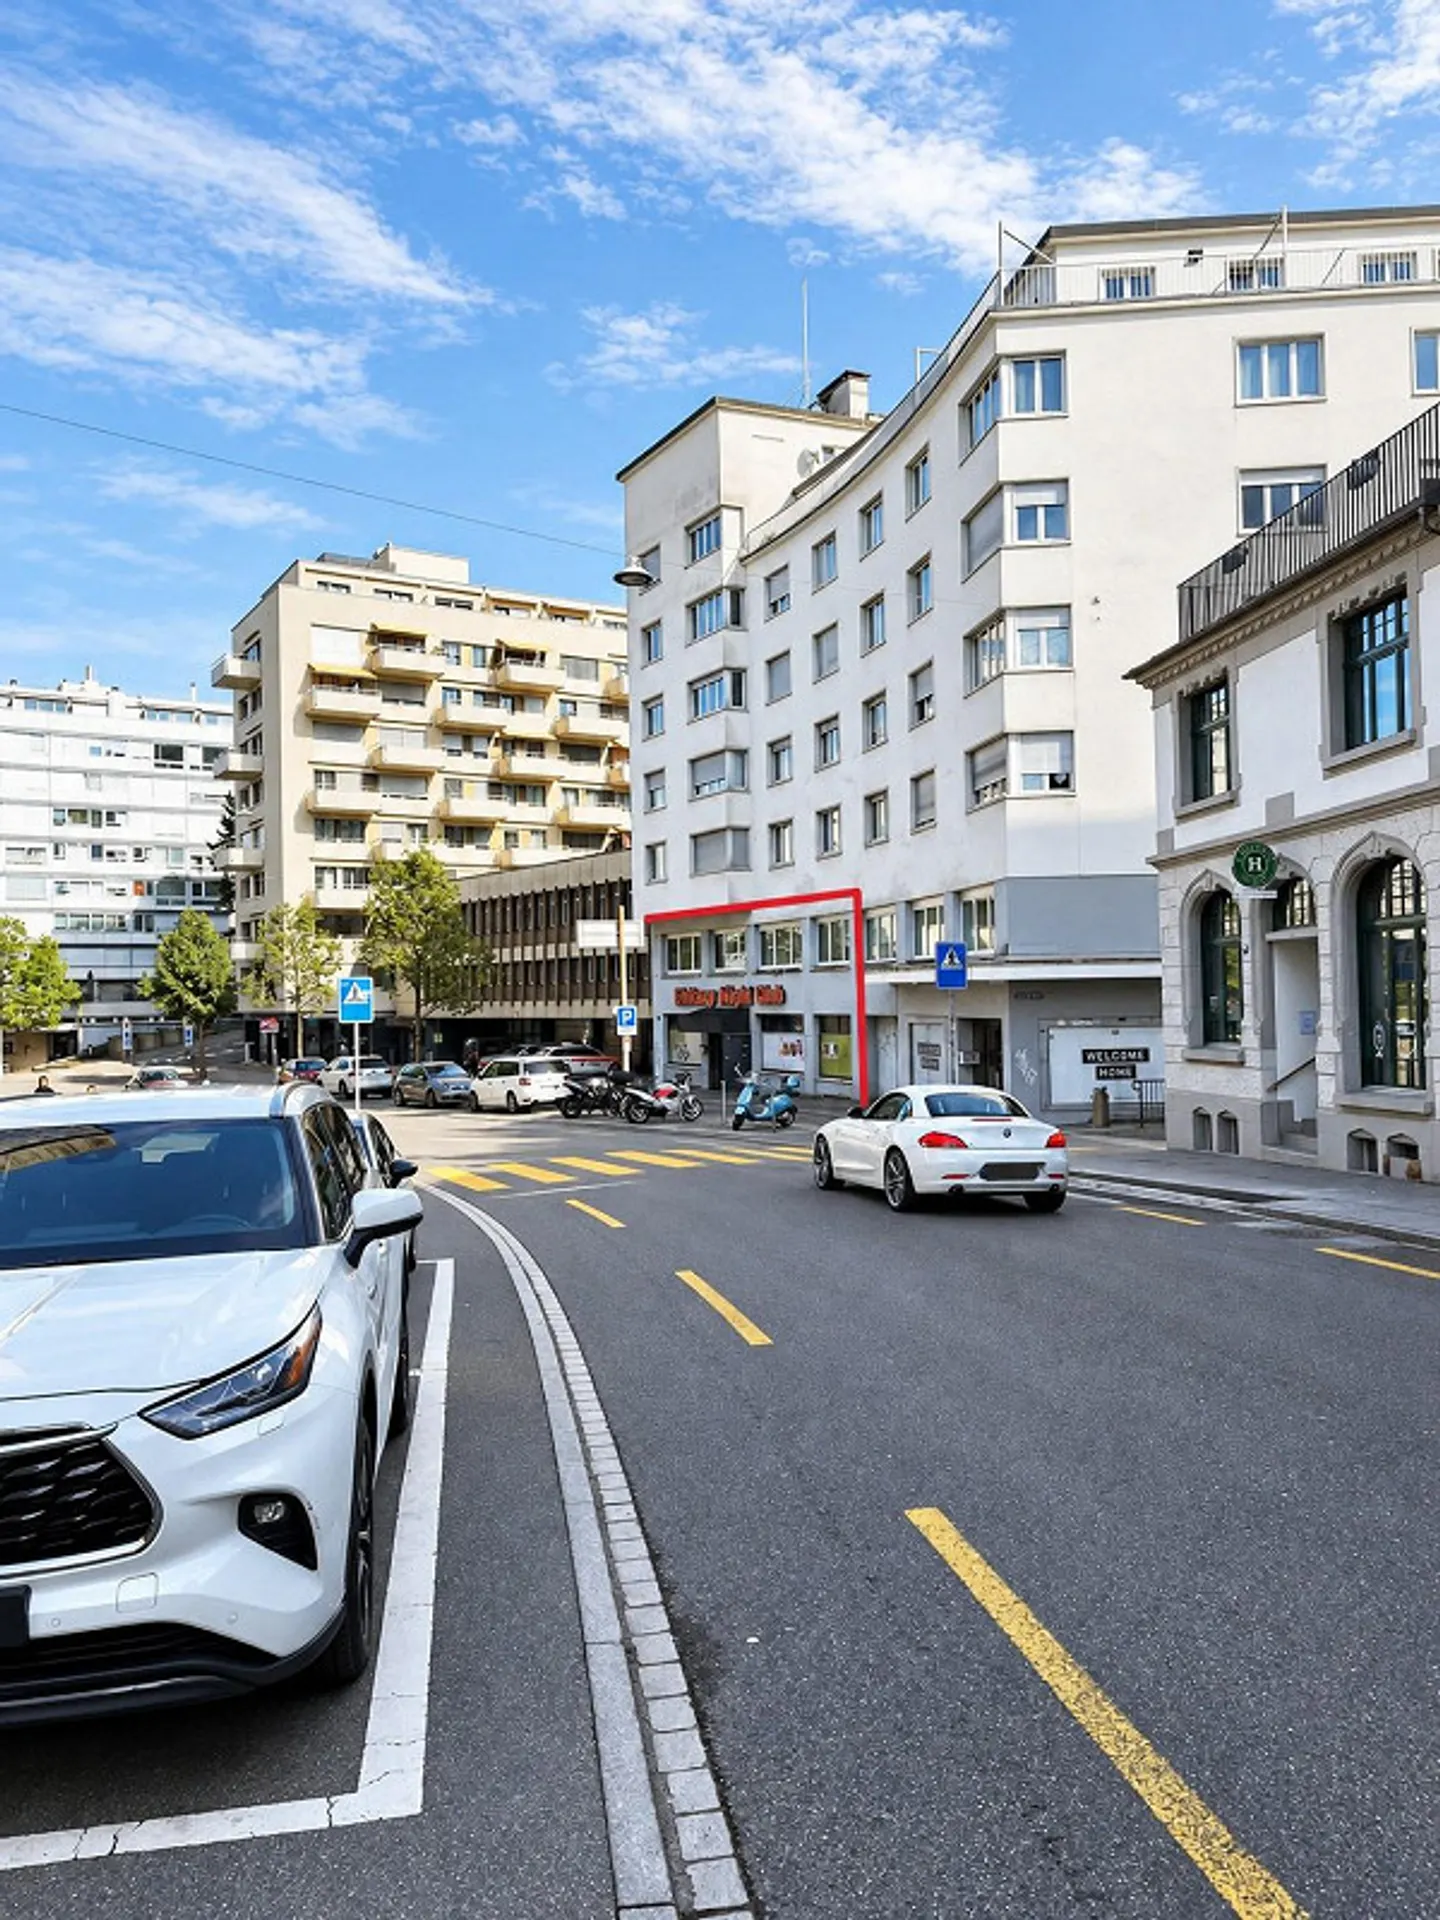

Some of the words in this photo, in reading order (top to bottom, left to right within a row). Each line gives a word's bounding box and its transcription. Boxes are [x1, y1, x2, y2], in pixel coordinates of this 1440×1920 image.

[622, 1010, 632, 1025] P
[1085, 1050, 1145, 1062] WELCOME
[1099, 1066, 1132, 1077] HOME
